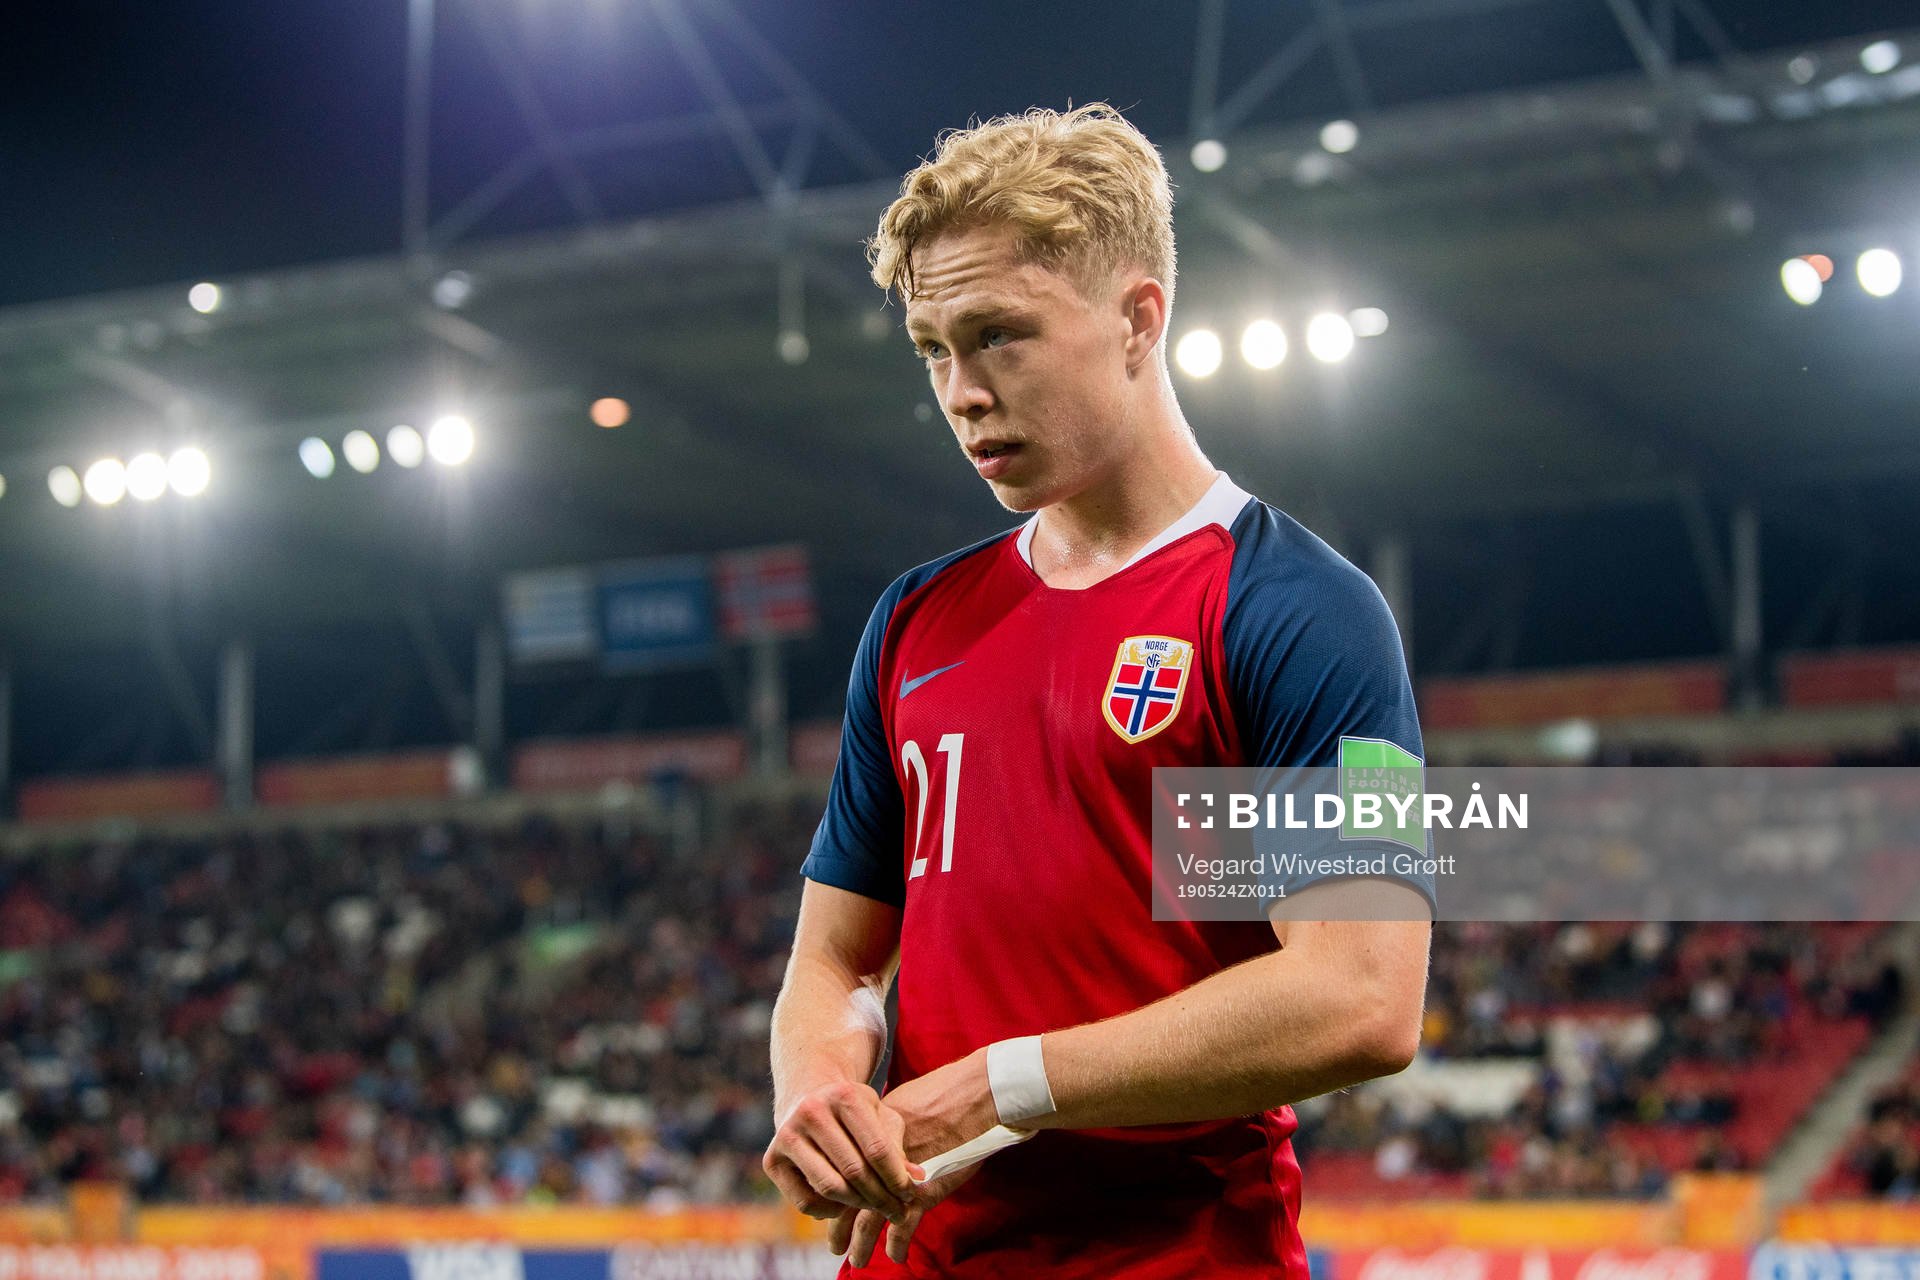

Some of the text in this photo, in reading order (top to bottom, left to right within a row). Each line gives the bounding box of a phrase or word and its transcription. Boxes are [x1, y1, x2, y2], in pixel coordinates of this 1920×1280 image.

[1144, 640, 1168, 651] NORGE
[1347, 768, 1419, 792] LIVING
[901, 733, 965, 881] 21
